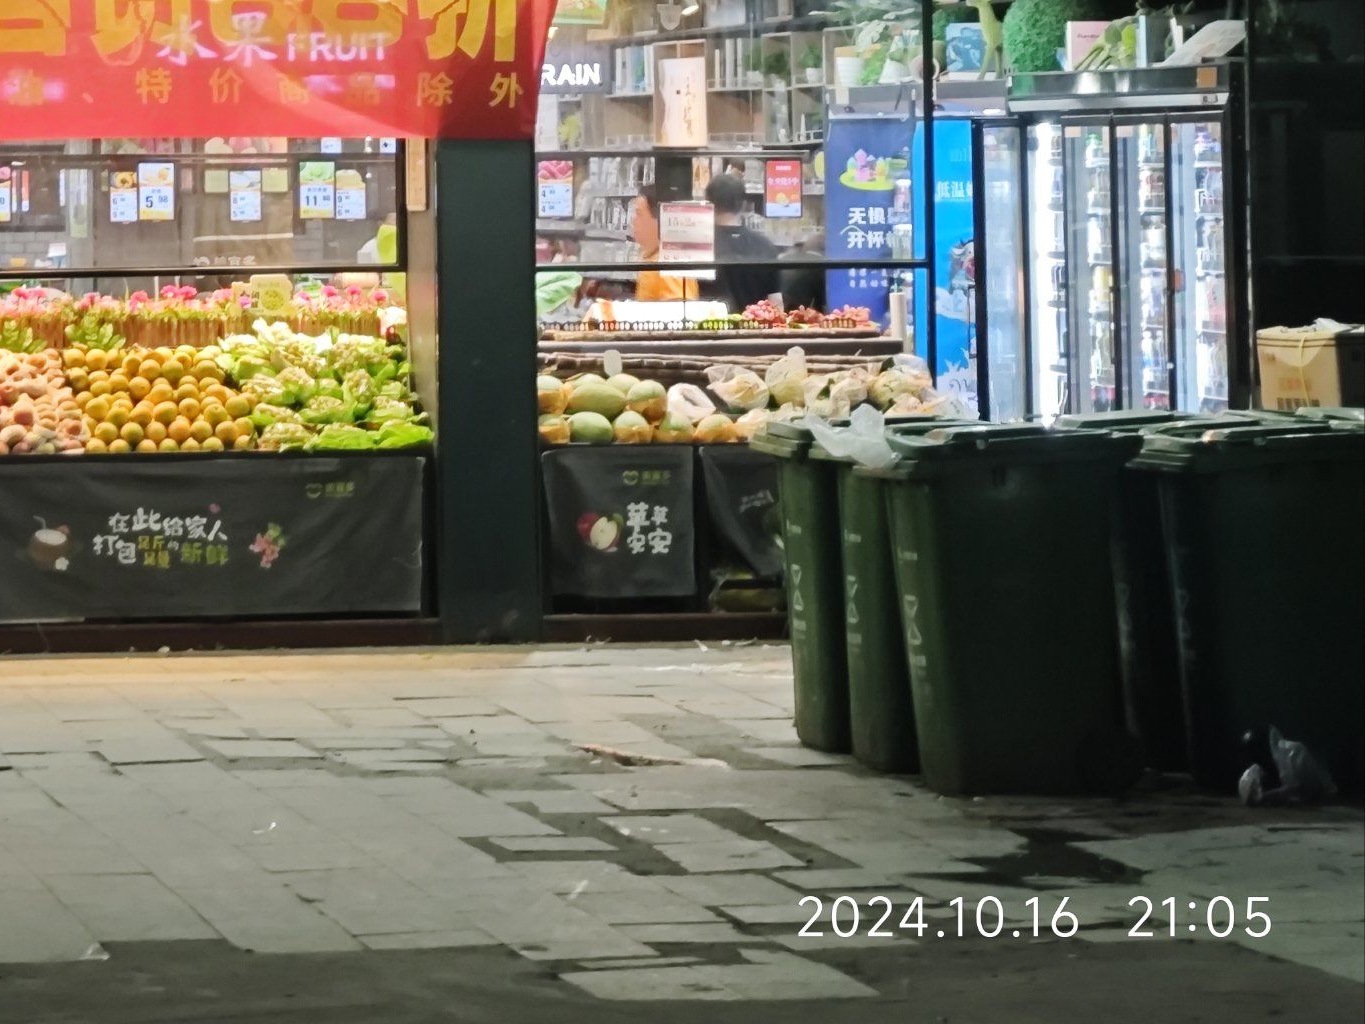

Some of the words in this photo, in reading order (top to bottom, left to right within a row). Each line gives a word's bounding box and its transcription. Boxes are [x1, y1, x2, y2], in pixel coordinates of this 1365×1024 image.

[157, 11, 280, 67] 水果
[286, 32, 390, 63] FRUIT
[145, 195, 154, 208] 5
[305, 195, 318, 207] 11
[847, 230, 911, 249] 开怀
[107, 506, 229, 542] 在此给家人
